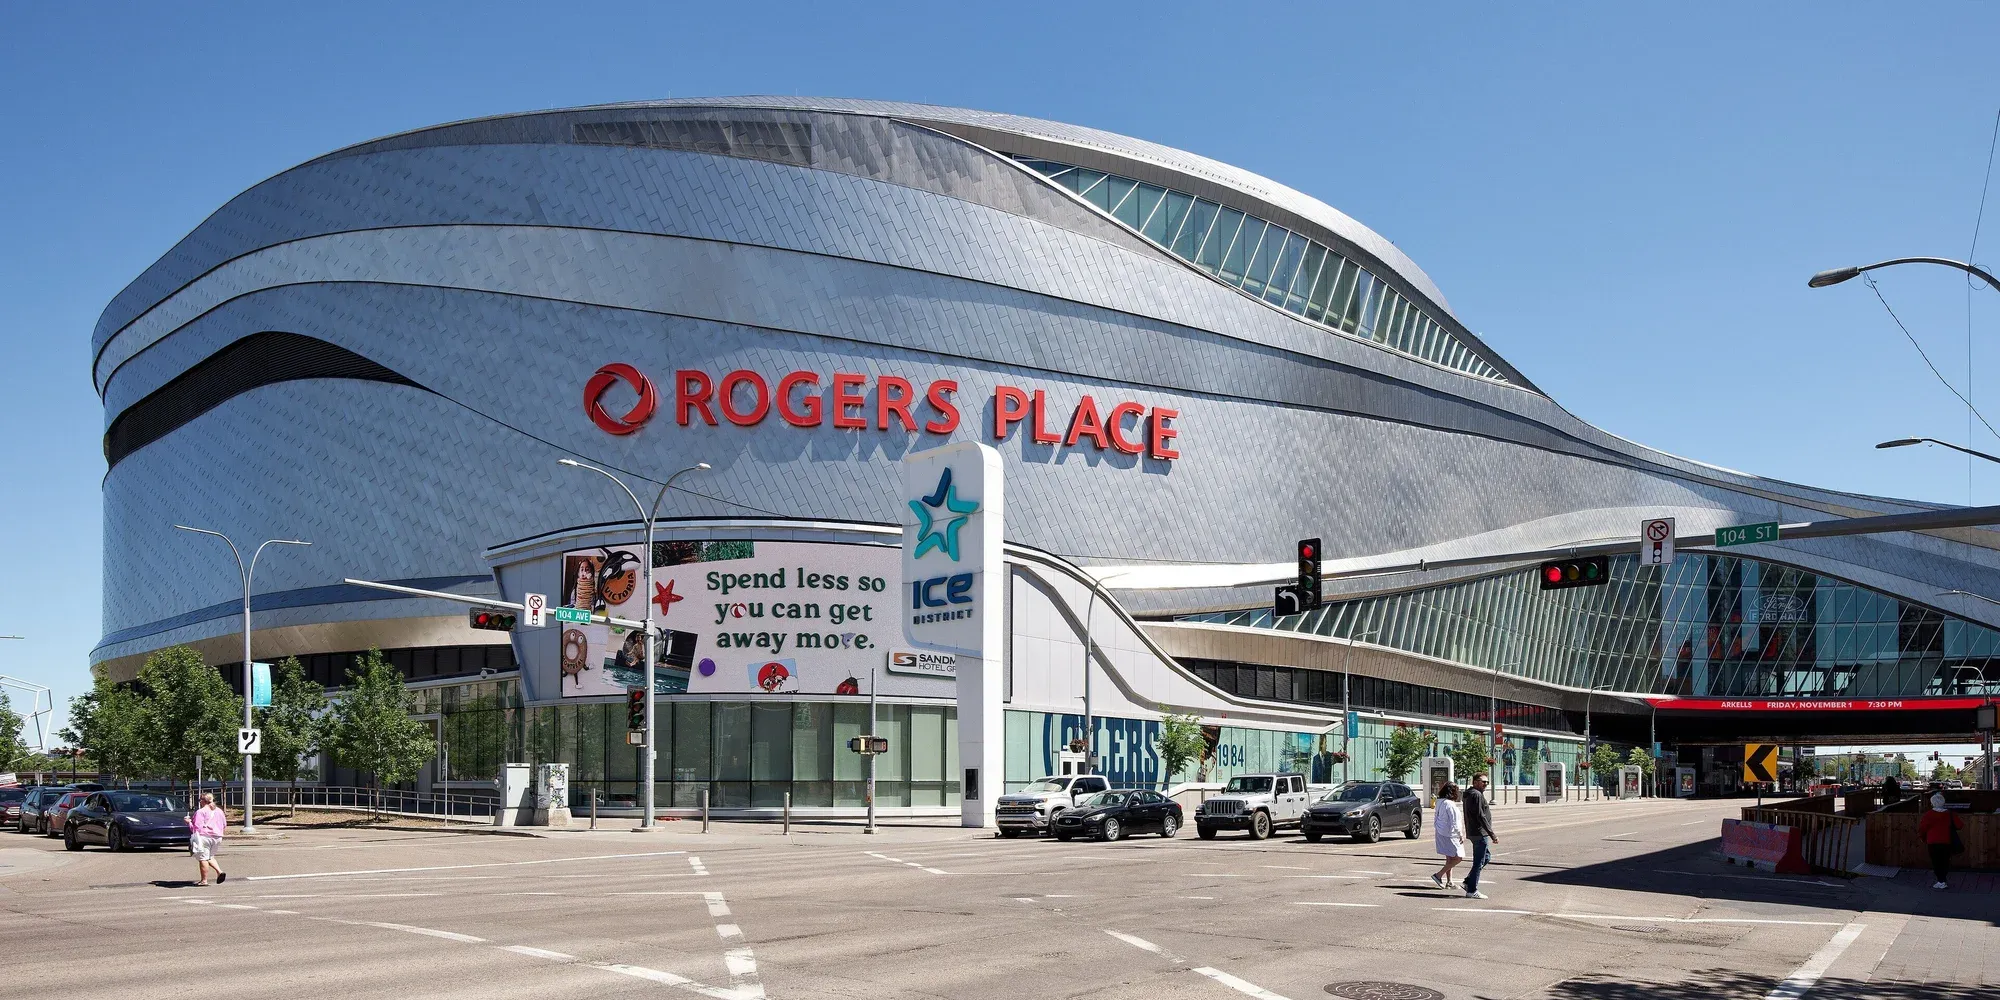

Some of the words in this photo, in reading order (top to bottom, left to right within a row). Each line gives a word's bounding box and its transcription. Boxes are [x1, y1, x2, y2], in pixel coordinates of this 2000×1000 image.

[675, 369, 962, 434] ROGERS
[994, 384, 1180, 460] PLACE
[1721, 528, 1747, 543] 104
[1756, 525, 1772, 539] ST
[604, 572, 635, 601] VICTORIA
[706, 567, 786, 595] Spend
[797, 567, 849, 591] less
[858, 575, 886, 592] so
[558, 609, 572, 620] 104
[575, 611, 589, 622] AVE
[771, 602, 821, 619] can
[829, 602, 873, 625] get
[912, 609, 973, 625] DISTRICT
[716, 631, 788, 655] away
[562, 658, 584, 670] ONTREAL
[918, 662, 945, 672] HOTEL
[1766, 701, 1798, 709] FRIDAY,
[1799, 701, 1847, 709] NOVEMBER
[1061, 714, 1160, 790] LERS
[1217, 743, 1244, 767] 1984
